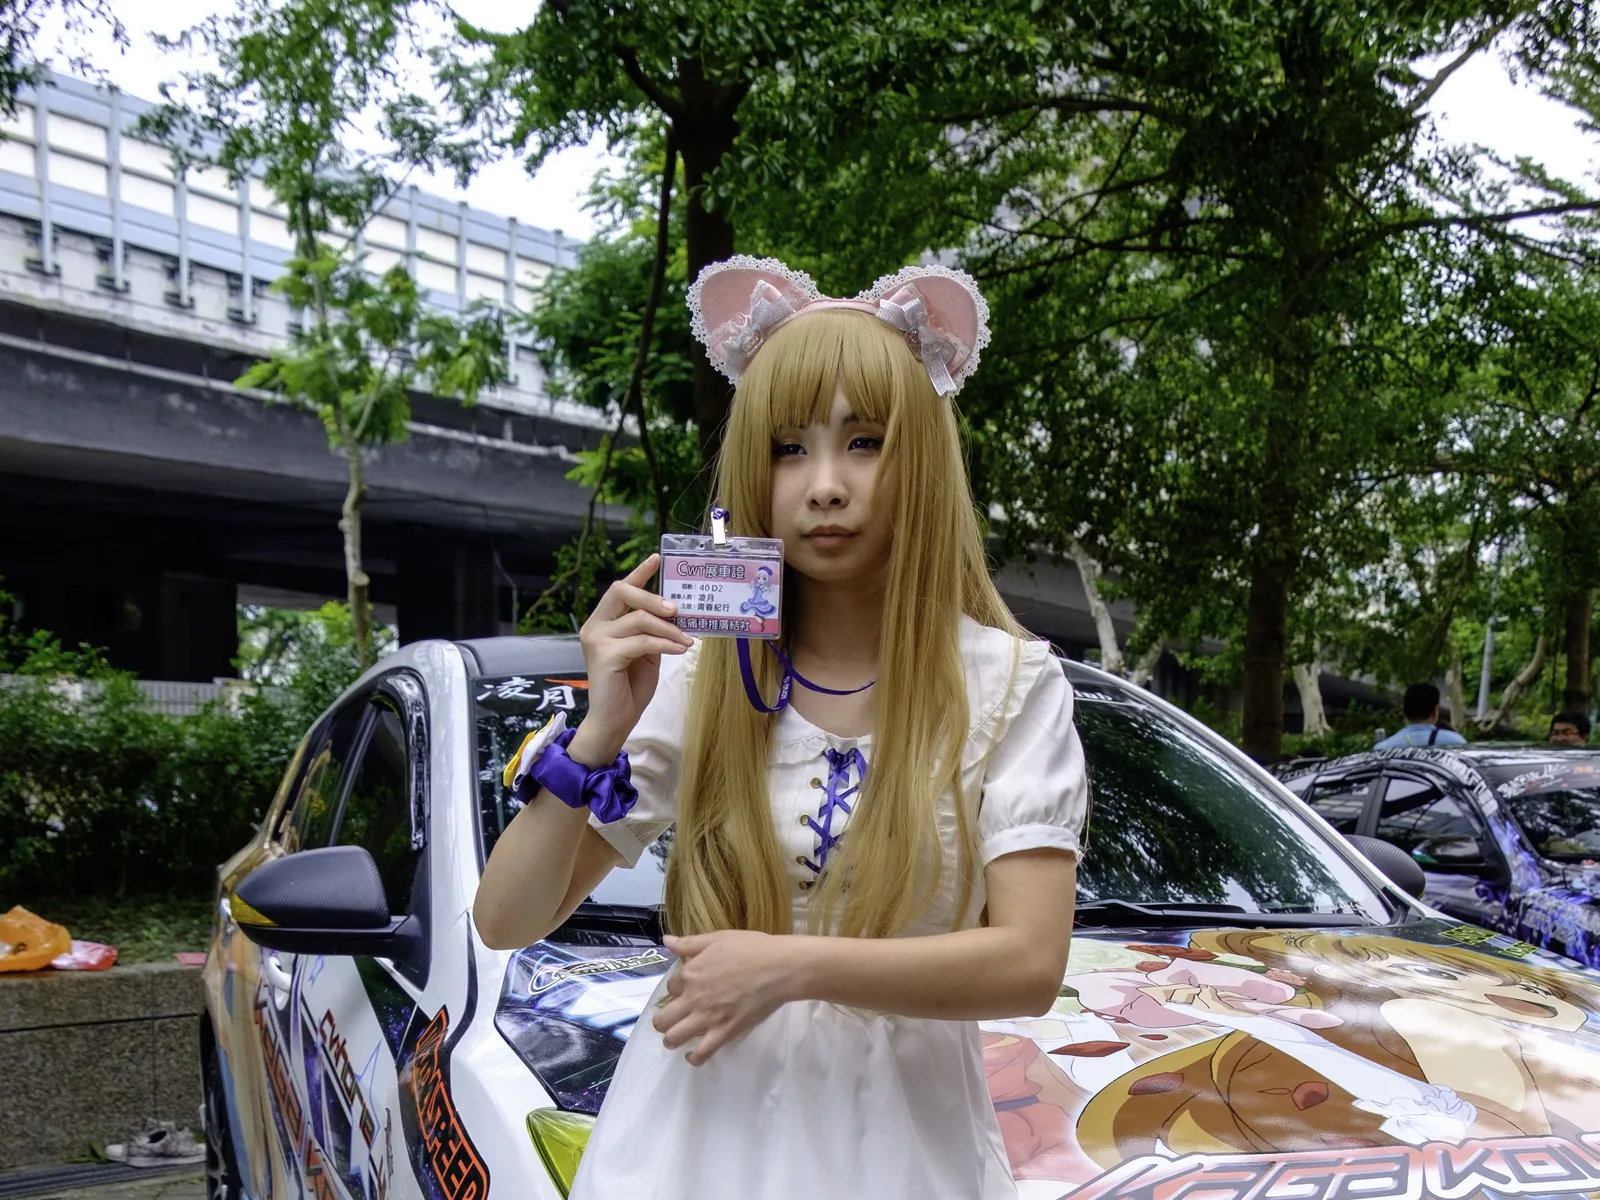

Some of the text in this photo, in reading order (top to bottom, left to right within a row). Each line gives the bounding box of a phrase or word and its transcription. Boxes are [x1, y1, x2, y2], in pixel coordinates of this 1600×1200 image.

[699, 584, 710, 592] 40
[711, 584, 723, 593] D2
[476, 676, 576, 711] 凌月
